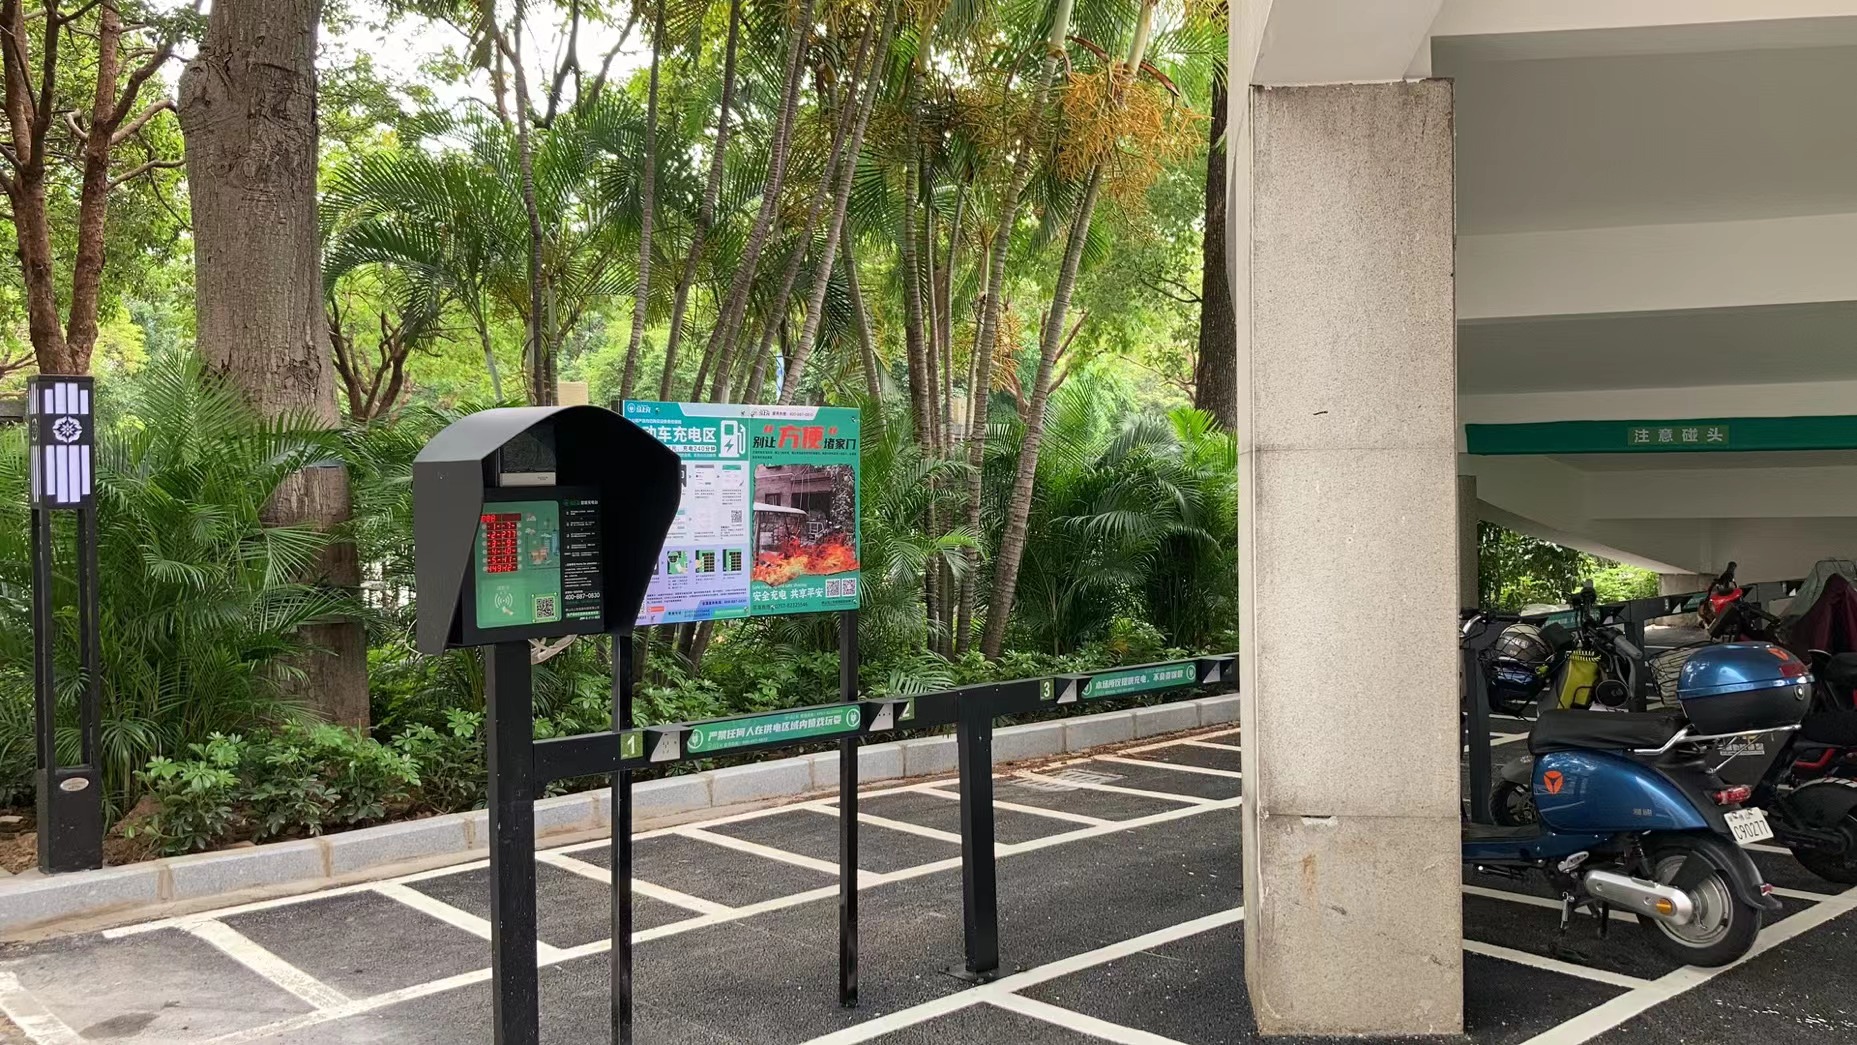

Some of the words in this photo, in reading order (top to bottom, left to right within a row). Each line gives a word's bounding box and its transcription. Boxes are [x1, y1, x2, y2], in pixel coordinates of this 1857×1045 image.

[1634, 428, 1723, 443] 注意碰头
[752, 590, 787, 602] 安全充电
[790, 587, 824, 599] 共享平安
[1044, 681, 1050, 697] 3
[627, 735, 635, 754] 1
[1733, 820, 1768, 840] C90277
